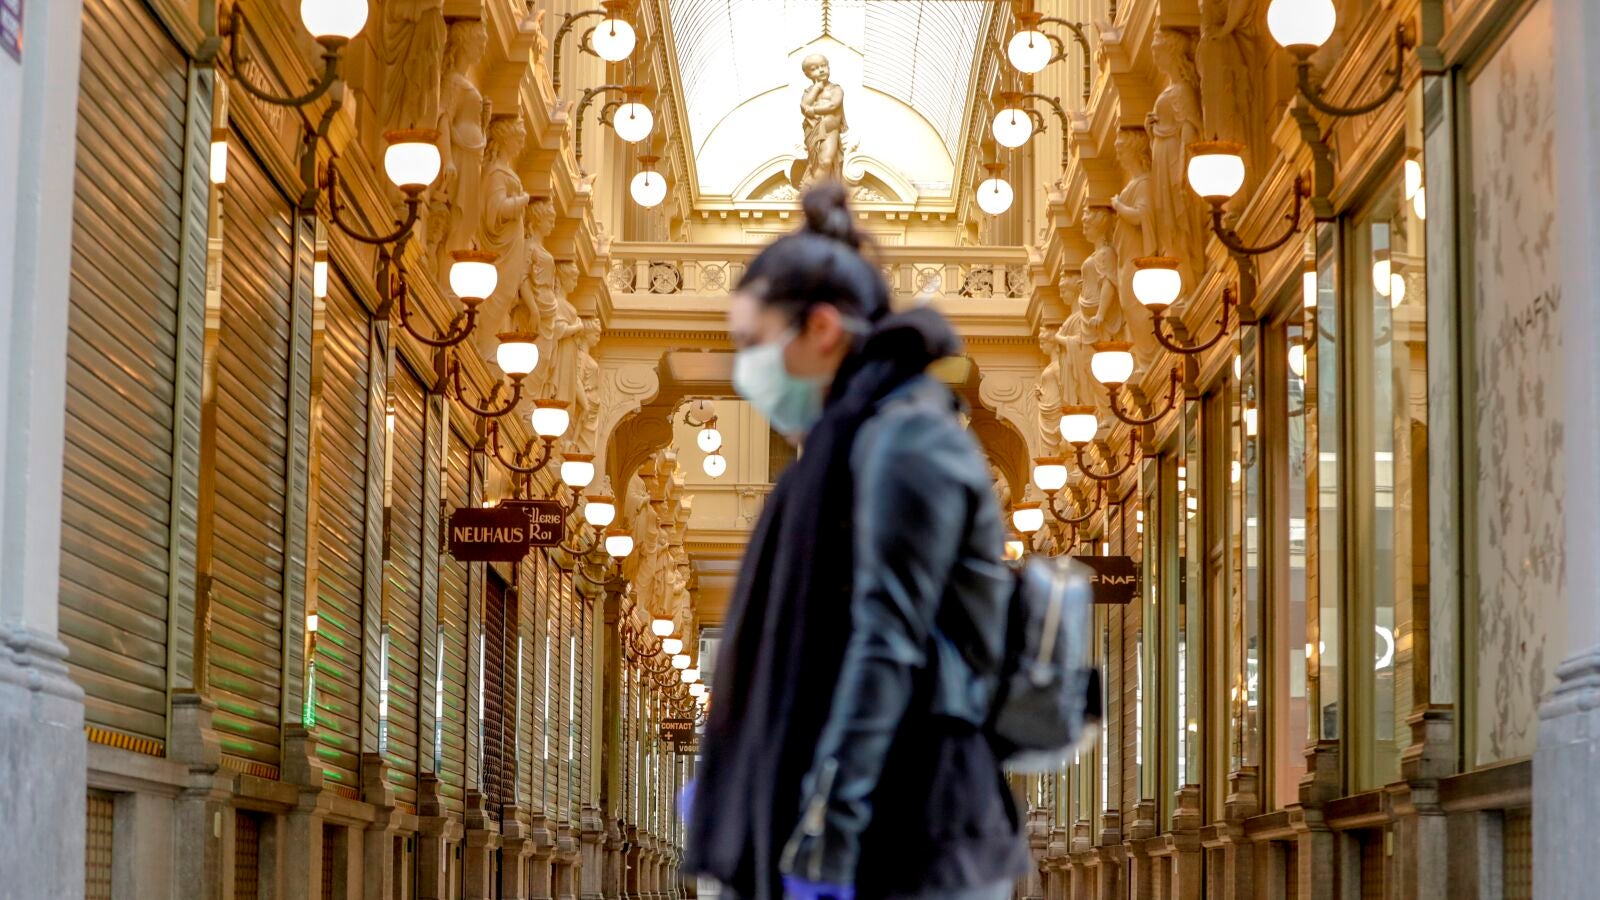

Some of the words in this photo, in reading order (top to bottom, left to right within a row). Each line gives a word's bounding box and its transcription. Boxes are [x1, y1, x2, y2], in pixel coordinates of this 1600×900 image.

[453, 526, 524, 543] NEUHAUS
[1101, 574, 1136, 585] NAF
[661, 722, 693, 730] CONTACT
